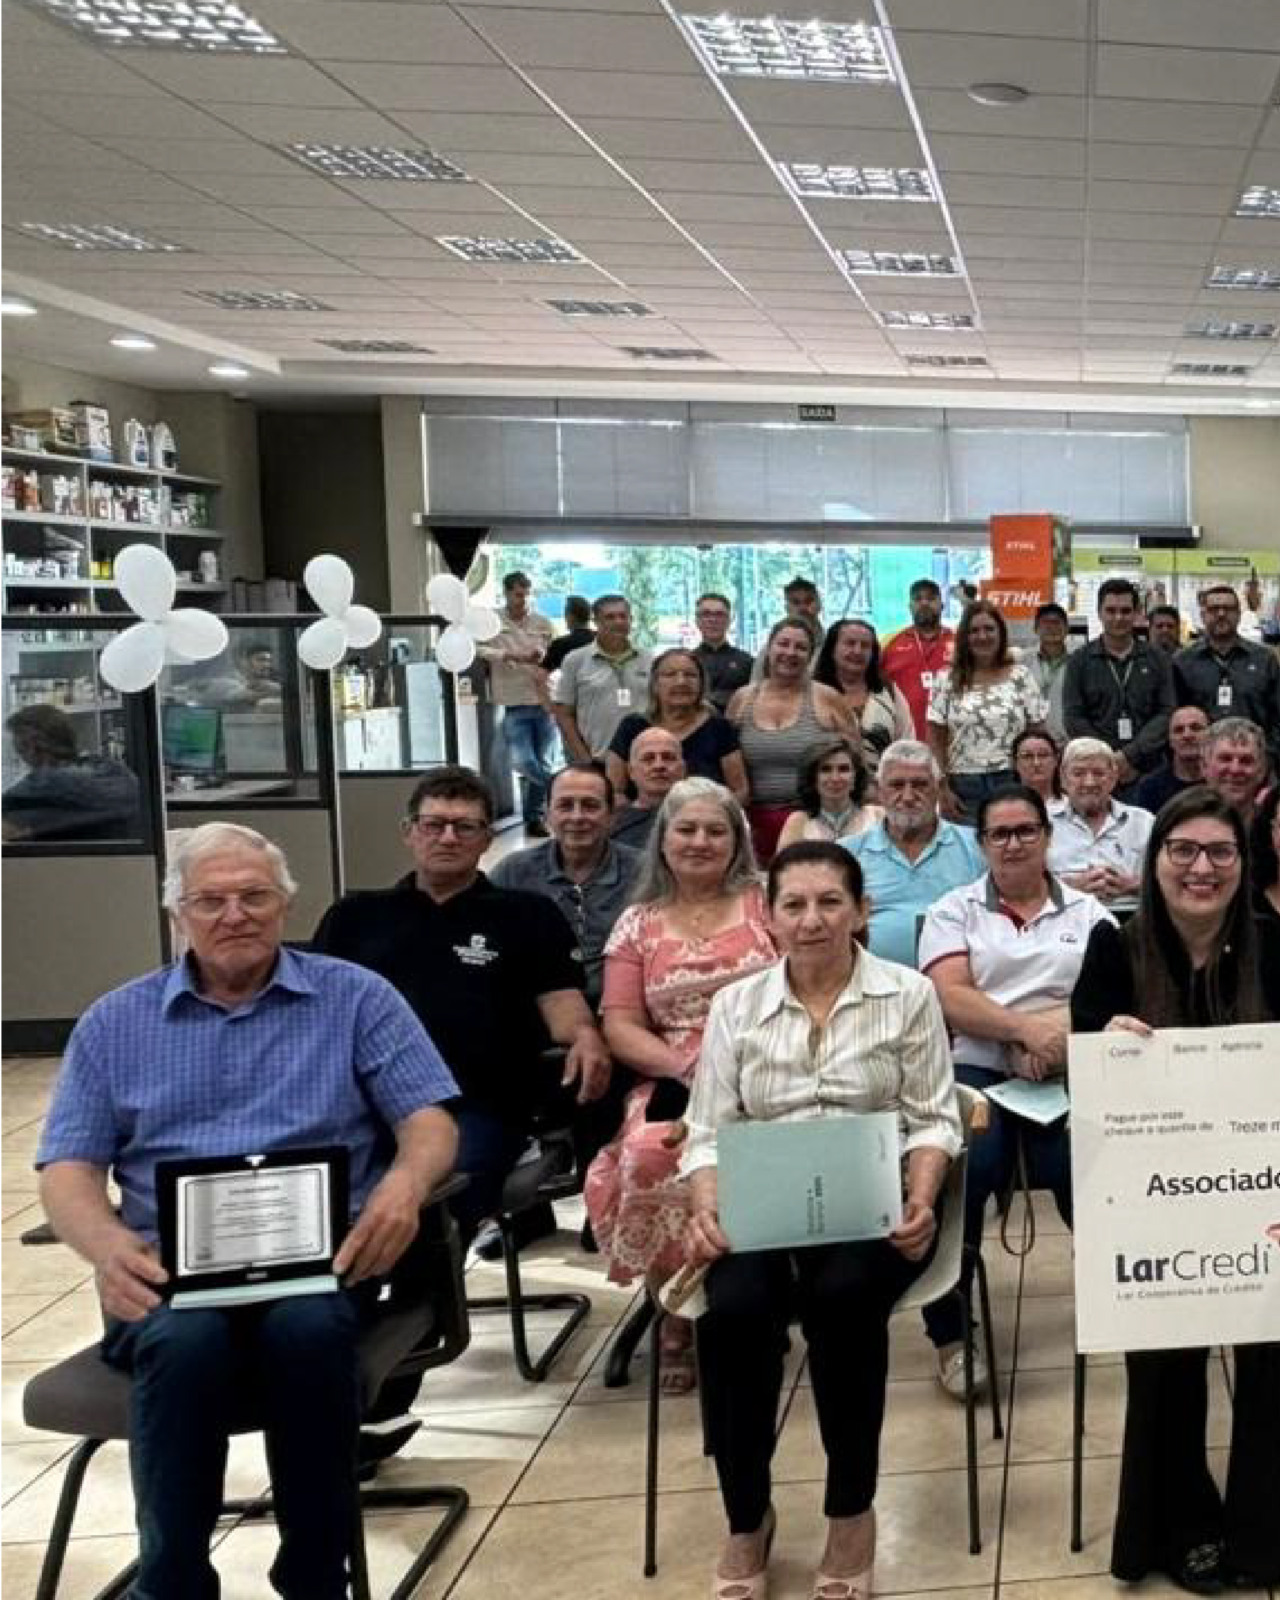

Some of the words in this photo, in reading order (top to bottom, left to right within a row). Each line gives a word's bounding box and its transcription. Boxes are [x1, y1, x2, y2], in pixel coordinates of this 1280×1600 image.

[987, 590, 1041, 607] STIHL
[1228, 1120, 1269, 1134] Treze
[1115, 1243, 1272, 1283] LarCredi
